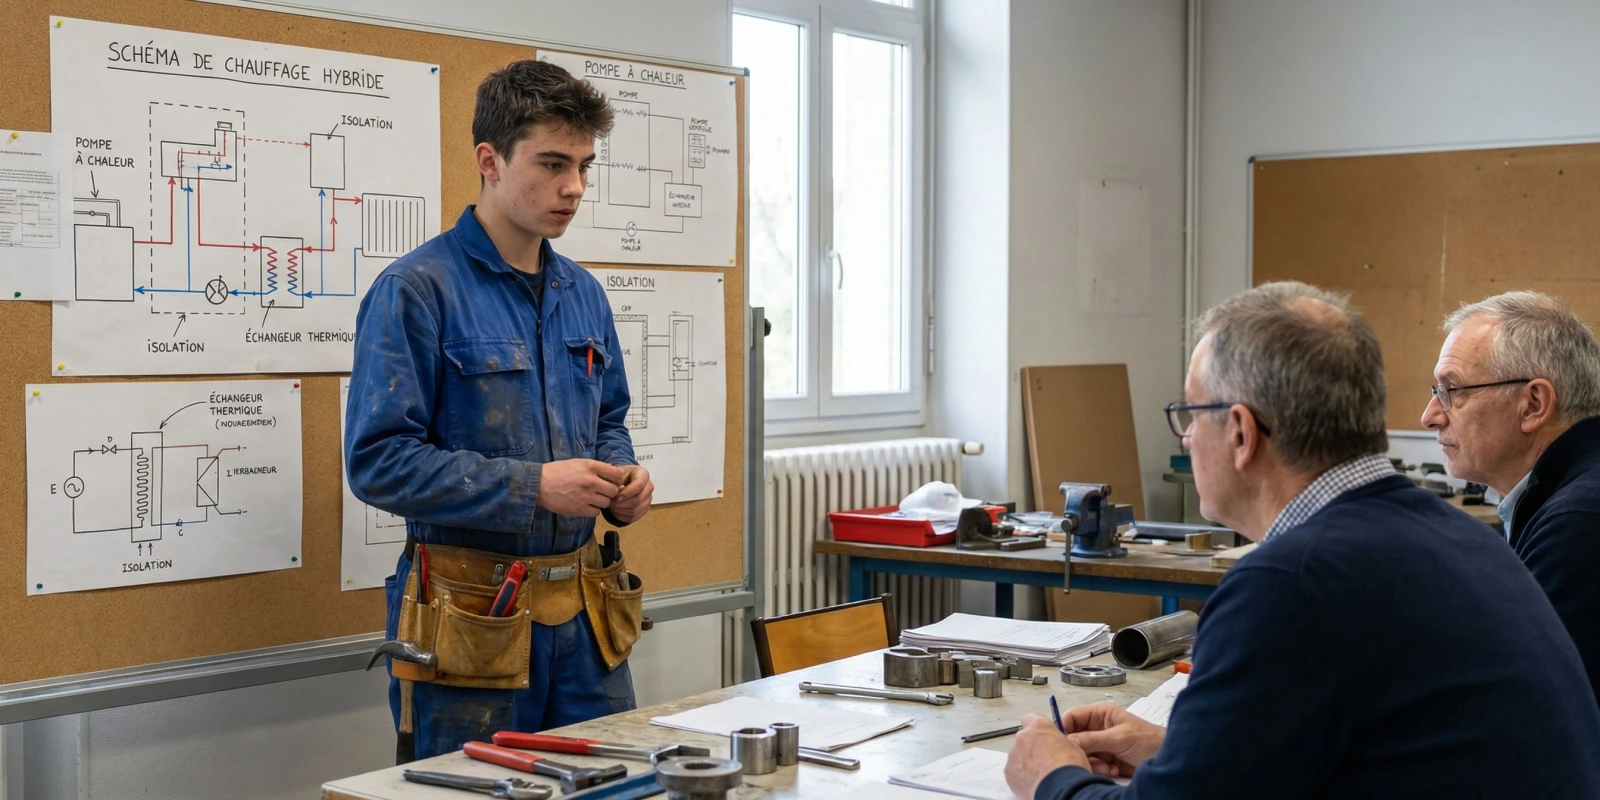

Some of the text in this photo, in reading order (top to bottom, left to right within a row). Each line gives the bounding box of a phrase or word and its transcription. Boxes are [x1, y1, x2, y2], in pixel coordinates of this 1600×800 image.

[107, 40, 384, 90] SCHÉMA DE CHAUFFAGE HYBRIDE
[585, 60, 685, 86] POMPE À CHALEUR
[341, 114, 393, 130] ISOLATION
[75, 136, 112, 150] POMPE
[75, 150, 135, 168] À CHALEUR
[245, 327, 302, 343] ÉCHANGEUR
[209, 390, 263, 404] ÉCHANGEUR
[209, 405, 263, 415] THERMIQUE
[50, 483, 57, 495] E
[122, 558, 173, 573] ISOLATION
